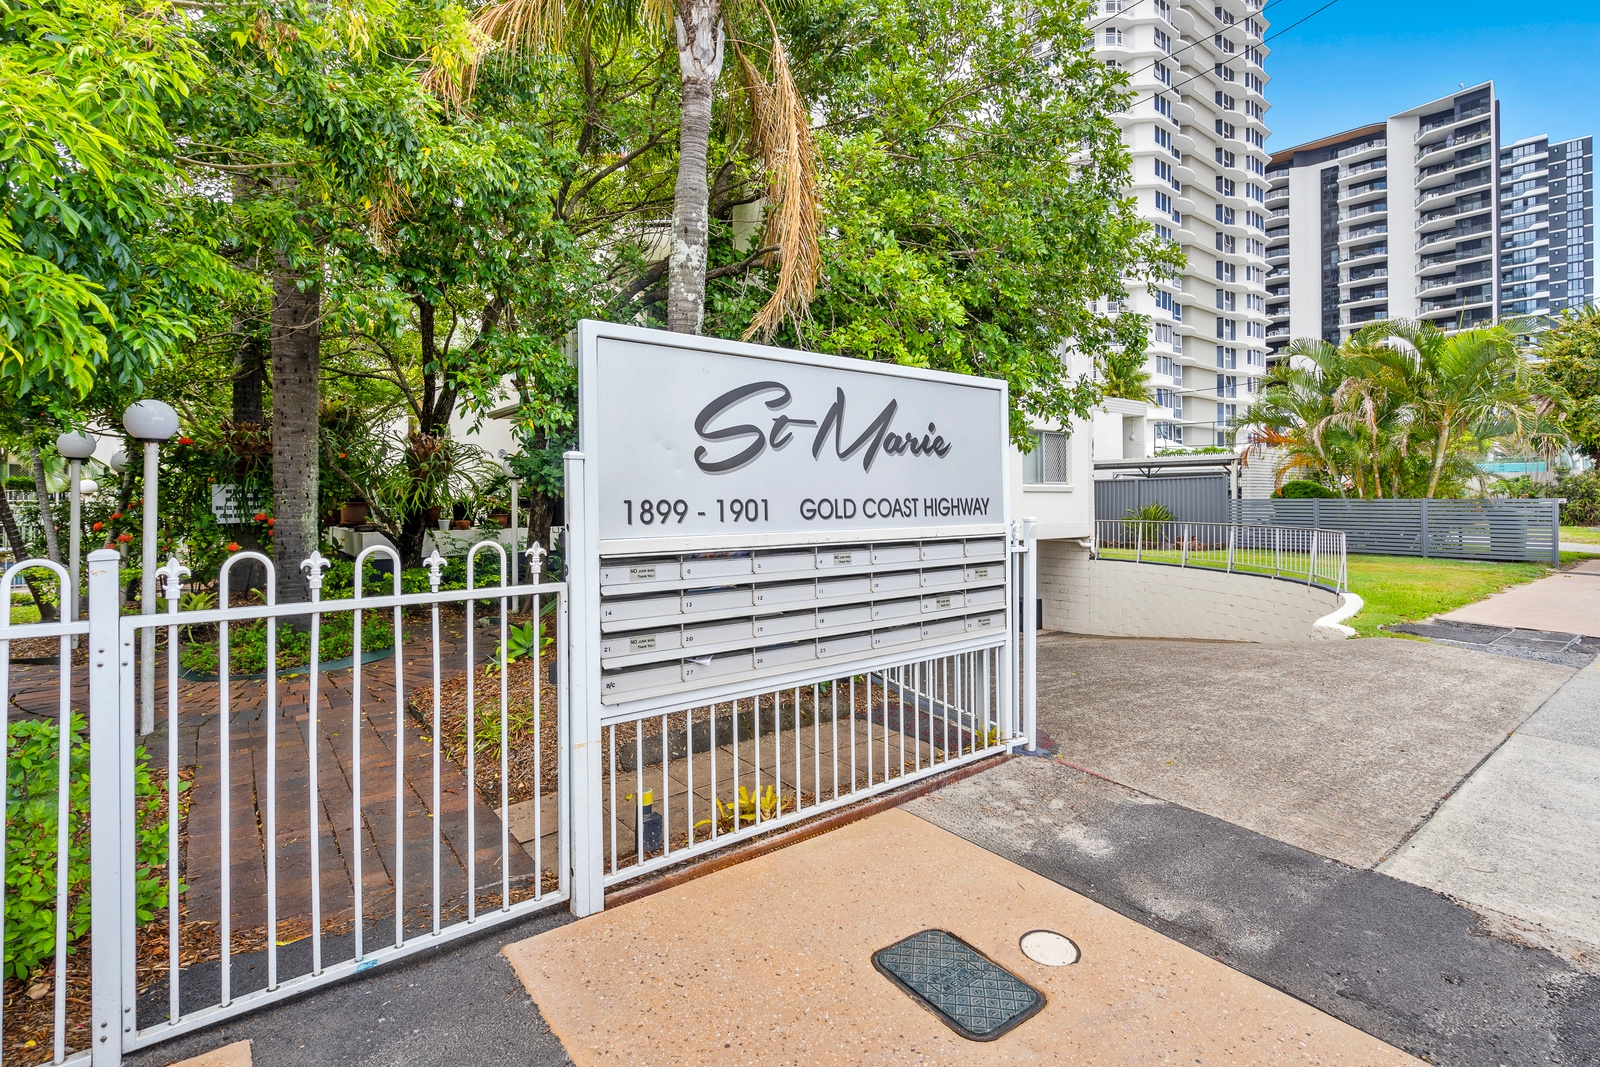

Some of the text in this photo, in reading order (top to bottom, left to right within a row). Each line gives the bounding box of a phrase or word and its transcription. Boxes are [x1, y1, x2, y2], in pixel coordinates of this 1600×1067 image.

[694, 381, 951, 475] St Marie
[623, 499, 689, 526] 1899
[716, 498, 770, 524] 1901
[800, 498, 856, 521] GOLD
[863, 498, 919, 518] COAST
[924, 497, 990, 518] HIGHWAY
[930, 962, 966, 984] WATER
[943, 970, 977, 992] METER
